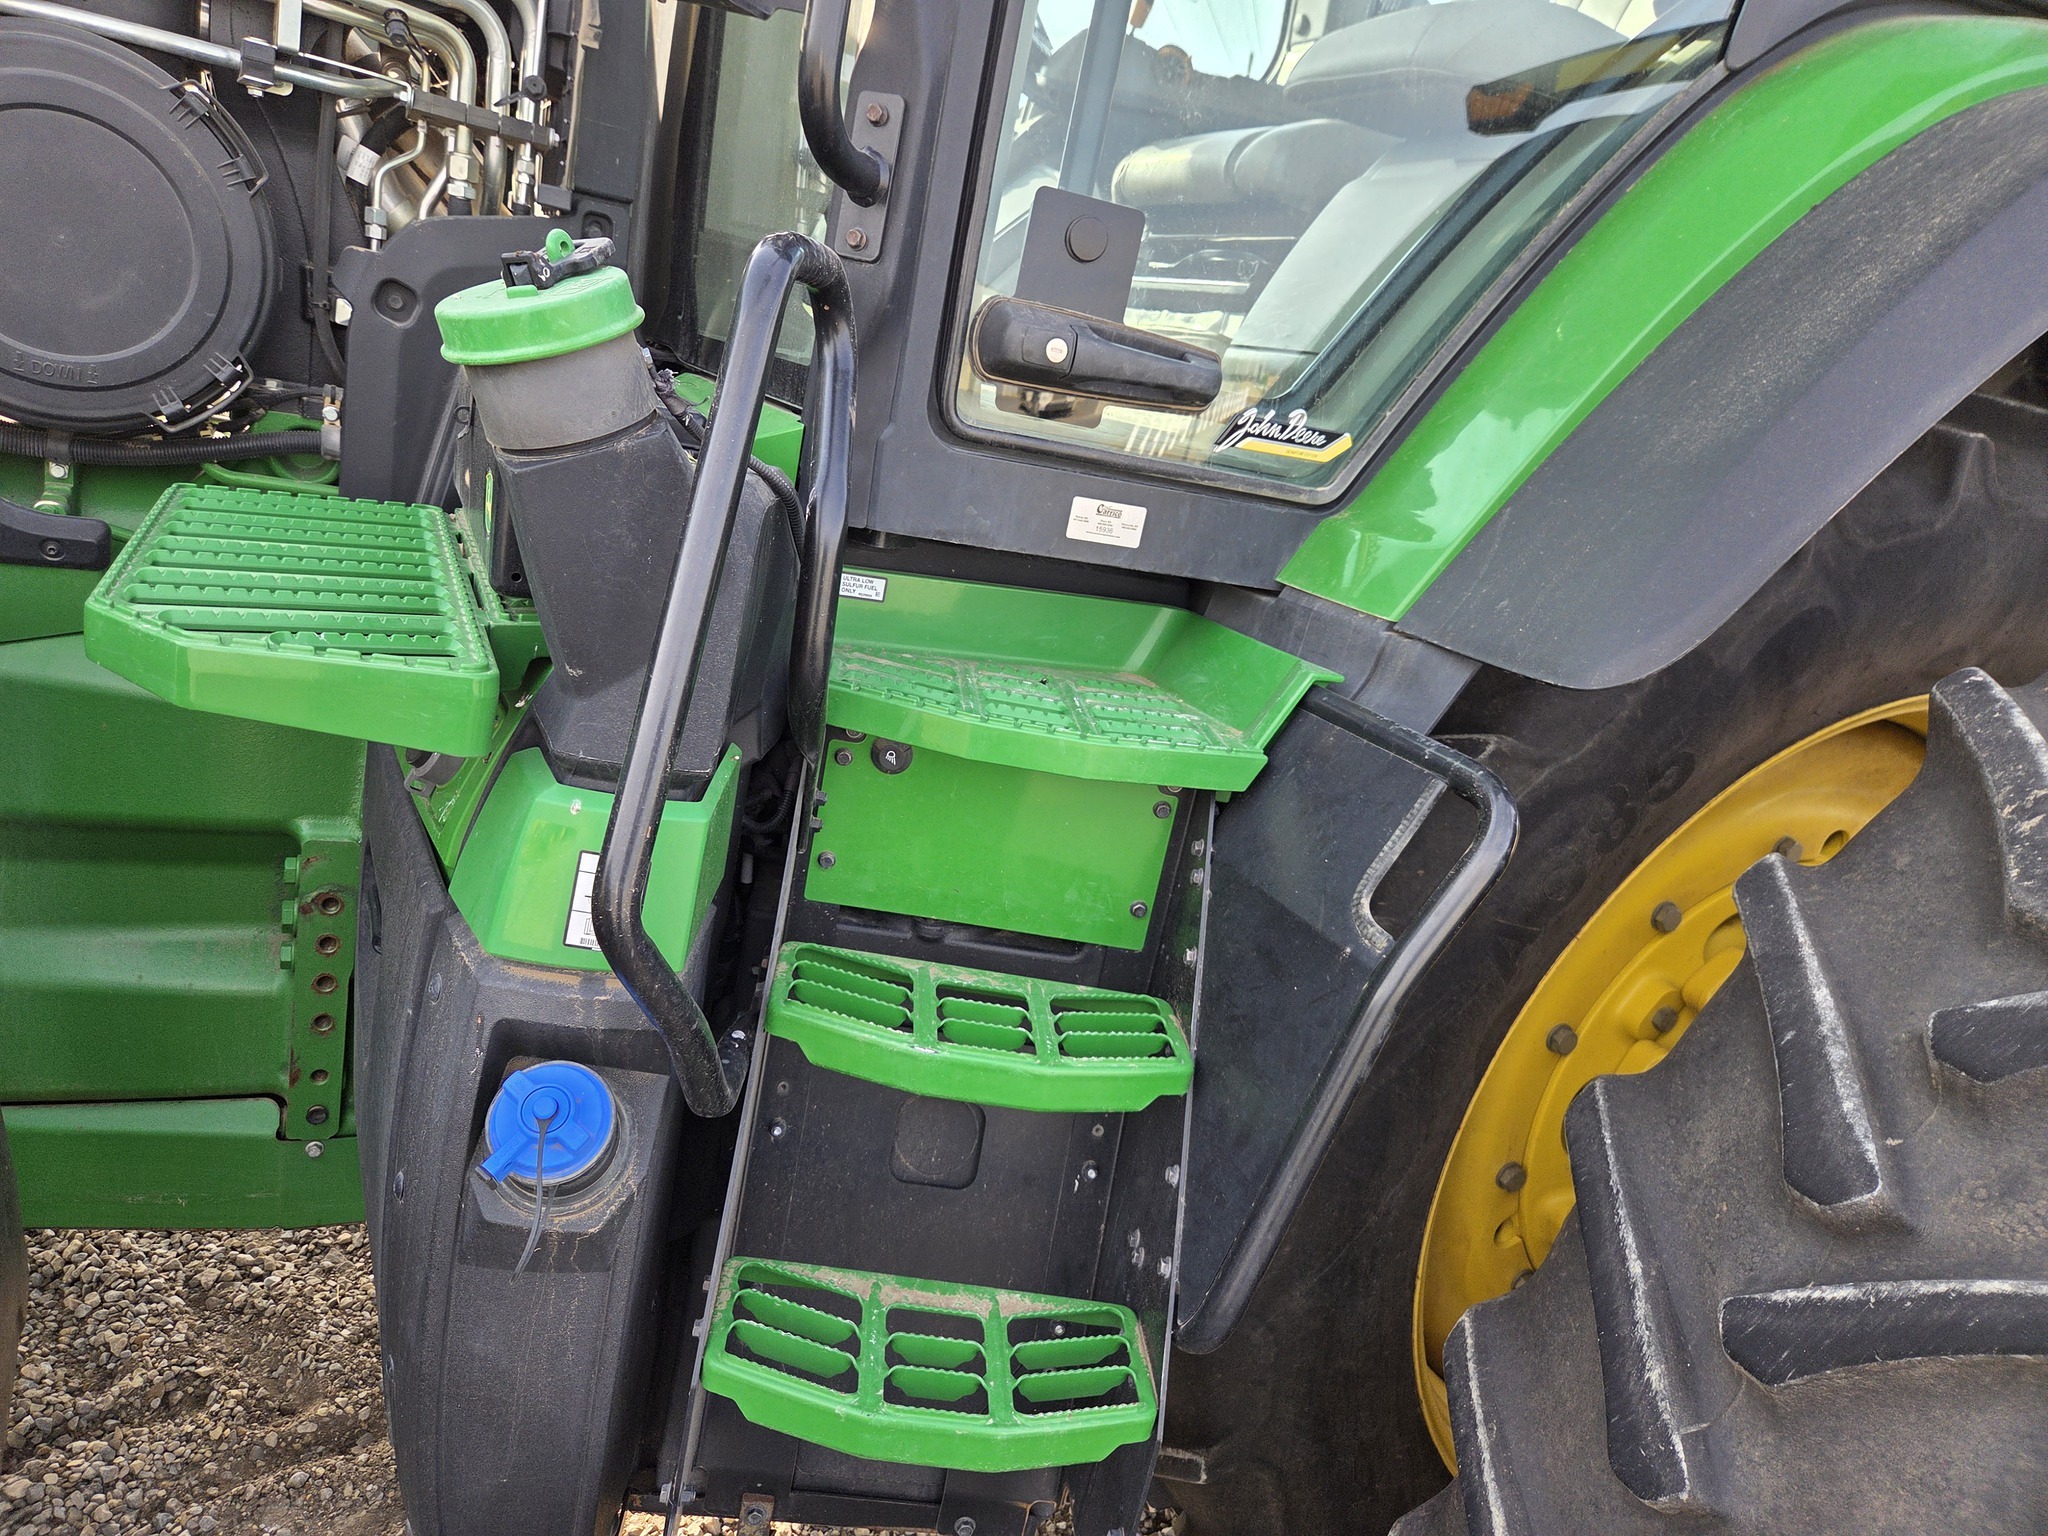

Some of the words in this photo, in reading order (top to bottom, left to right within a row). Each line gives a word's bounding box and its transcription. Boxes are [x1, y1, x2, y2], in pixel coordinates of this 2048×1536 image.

[1213, 407, 1282, 453] John
[1280, 408, 1328, 446] Deere
[1096, 503, 1123, 518] Carrico
[842, 575, 861, 583] ULTRA
[841, 581, 864, 589] SULFUR
